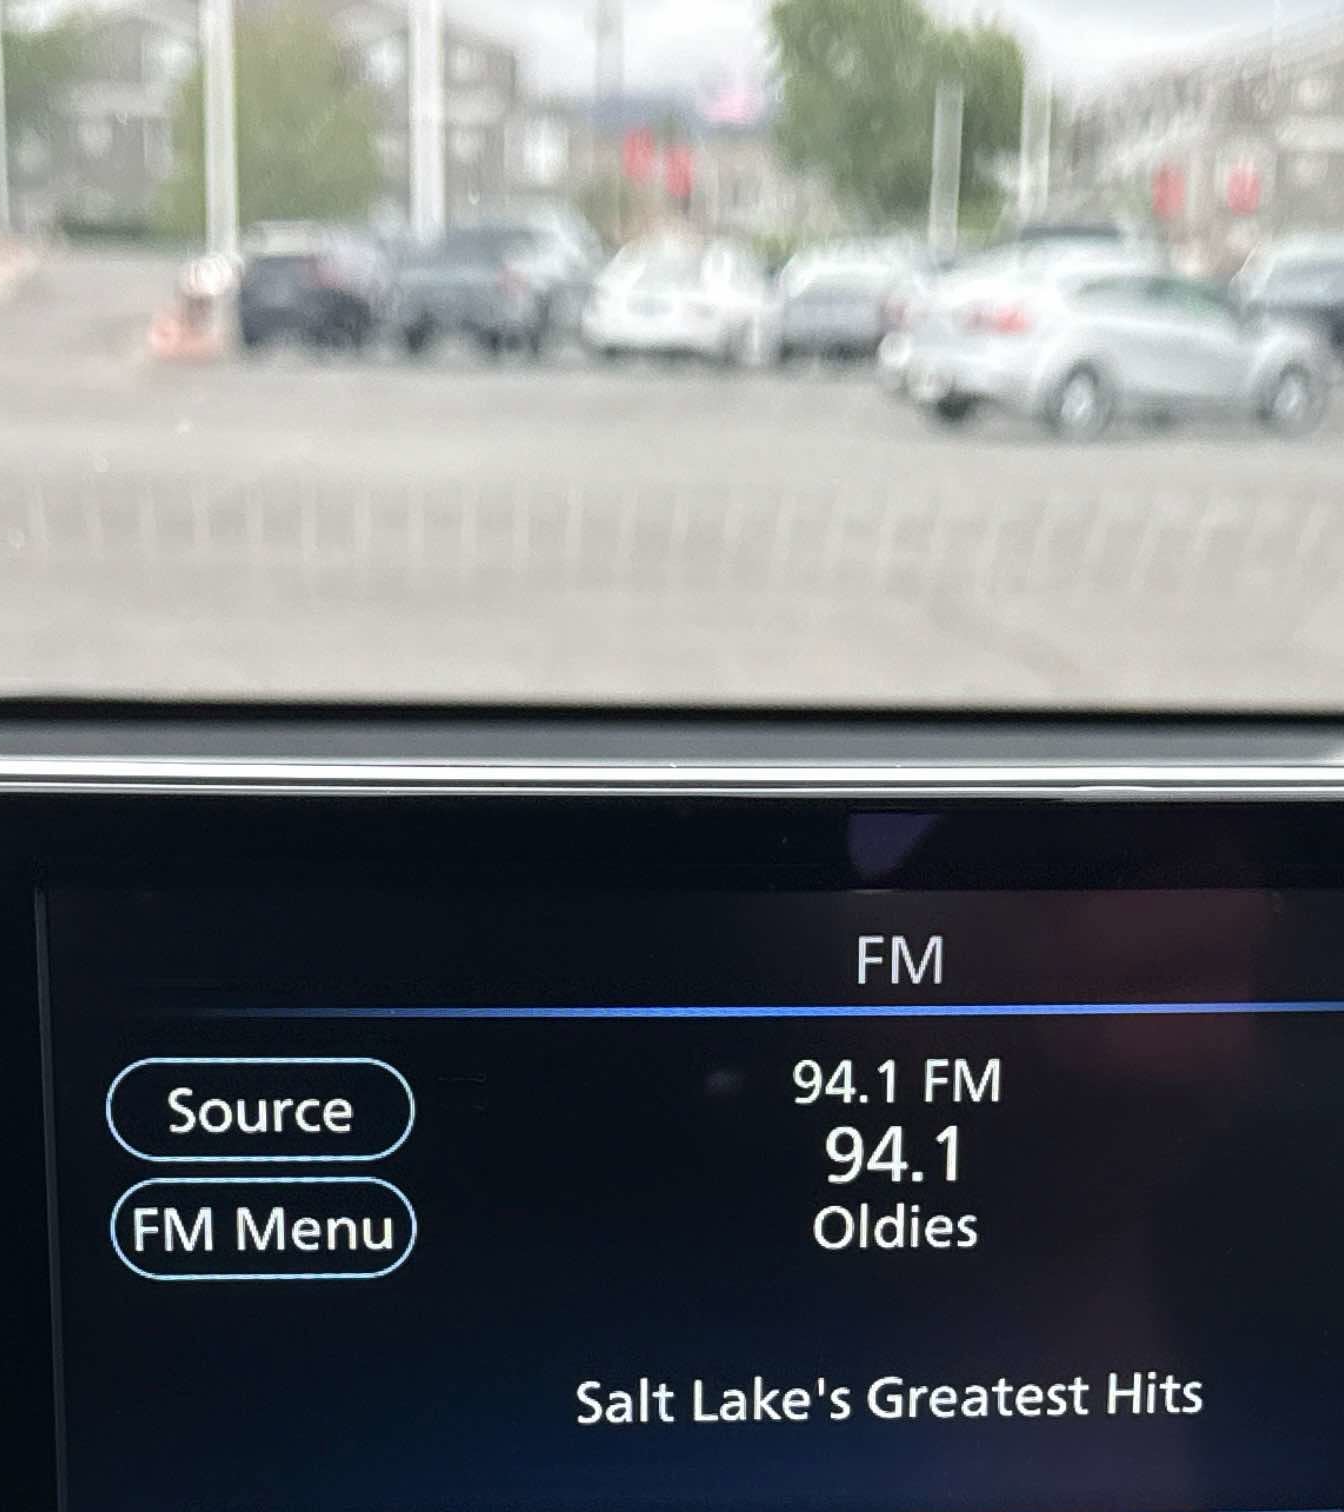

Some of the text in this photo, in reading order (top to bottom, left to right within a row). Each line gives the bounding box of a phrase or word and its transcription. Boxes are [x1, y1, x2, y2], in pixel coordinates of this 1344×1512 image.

[856, 934, 944, 986] FM
[792, 1057, 1002, 1106] 94.1 FM
[166, 1086, 355, 1136] Source
[824, 1124, 962, 1185] 94.1
[131, 1205, 395, 1253] FM Menu
[812, 1202, 979, 1251] Oldies
[574, 1371, 1204, 1426] Salt Lake's Greatest Hits
